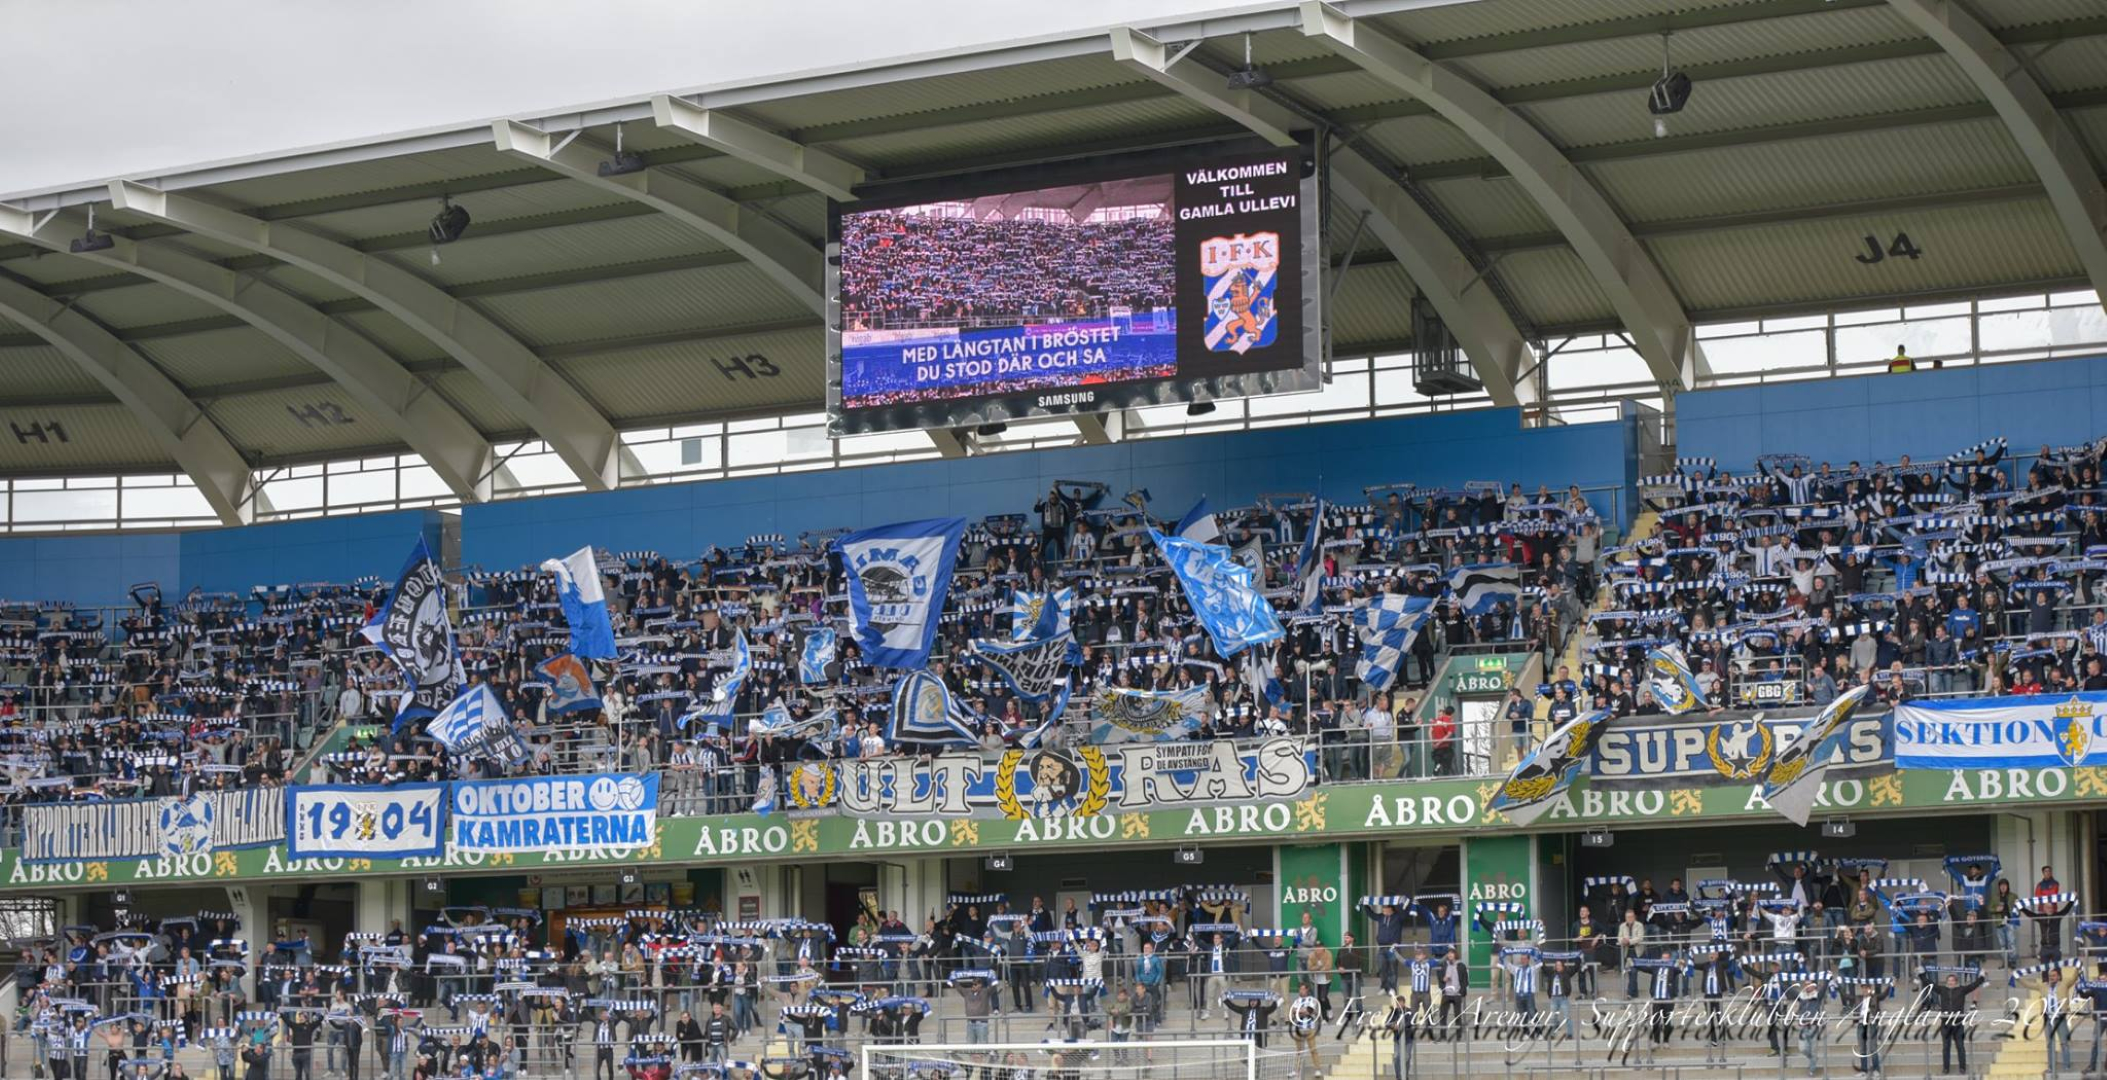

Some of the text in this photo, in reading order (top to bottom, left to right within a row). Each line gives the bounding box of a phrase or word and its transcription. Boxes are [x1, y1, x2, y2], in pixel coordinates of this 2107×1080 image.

[1186, 161, 1288, 186] VÄLKOMMEN
[1219, 184, 1255, 199] TILL
[1179, 195, 1296, 221] GAMLA ULLEVI
[1855, 232, 1922, 264] J4
[902, 325, 1121, 365] MED LÄNGTAN I BRÖSTET
[710, 353, 781, 381] H3
[917, 347, 1107, 382] DU STOD DÄR OCH SA
[1037, 391, 1096, 408] SAMSUNG
[9, 421, 70, 445] H1
[1456, 672, 1502, 691] ÅBRO
[1757, 685, 1782, 698] GBG
[1895, 719, 2054, 745] SEKTION
[1155, 744, 1196, 759] SYMPATI
[1598, 728, 1706, 775] SUP
[1156, 759, 1167, 770] DE
[840, 754, 983, 814] ULT
[456, 781, 587, 815] OKTOBER
[1364, 794, 1476, 828] ÅBRO
[23, 800, 158, 860] SUPPORTERKLUBBEN
[456, 814, 648, 848] KAMRATERNA
[693, 825, 788, 856] ÅBRO
[849, 819, 947, 849] ÅBRO
[993, 860, 1006, 868] G4
[1182, 853, 1196, 861] G5
[427, 882, 438, 891] G2
[623, 875, 635, 883] G3
[1469, 882, 1526, 900] ÅBRO
[116, 894, 127, 902] G1
[1283, 886, 1338, 904] ÅBRO
